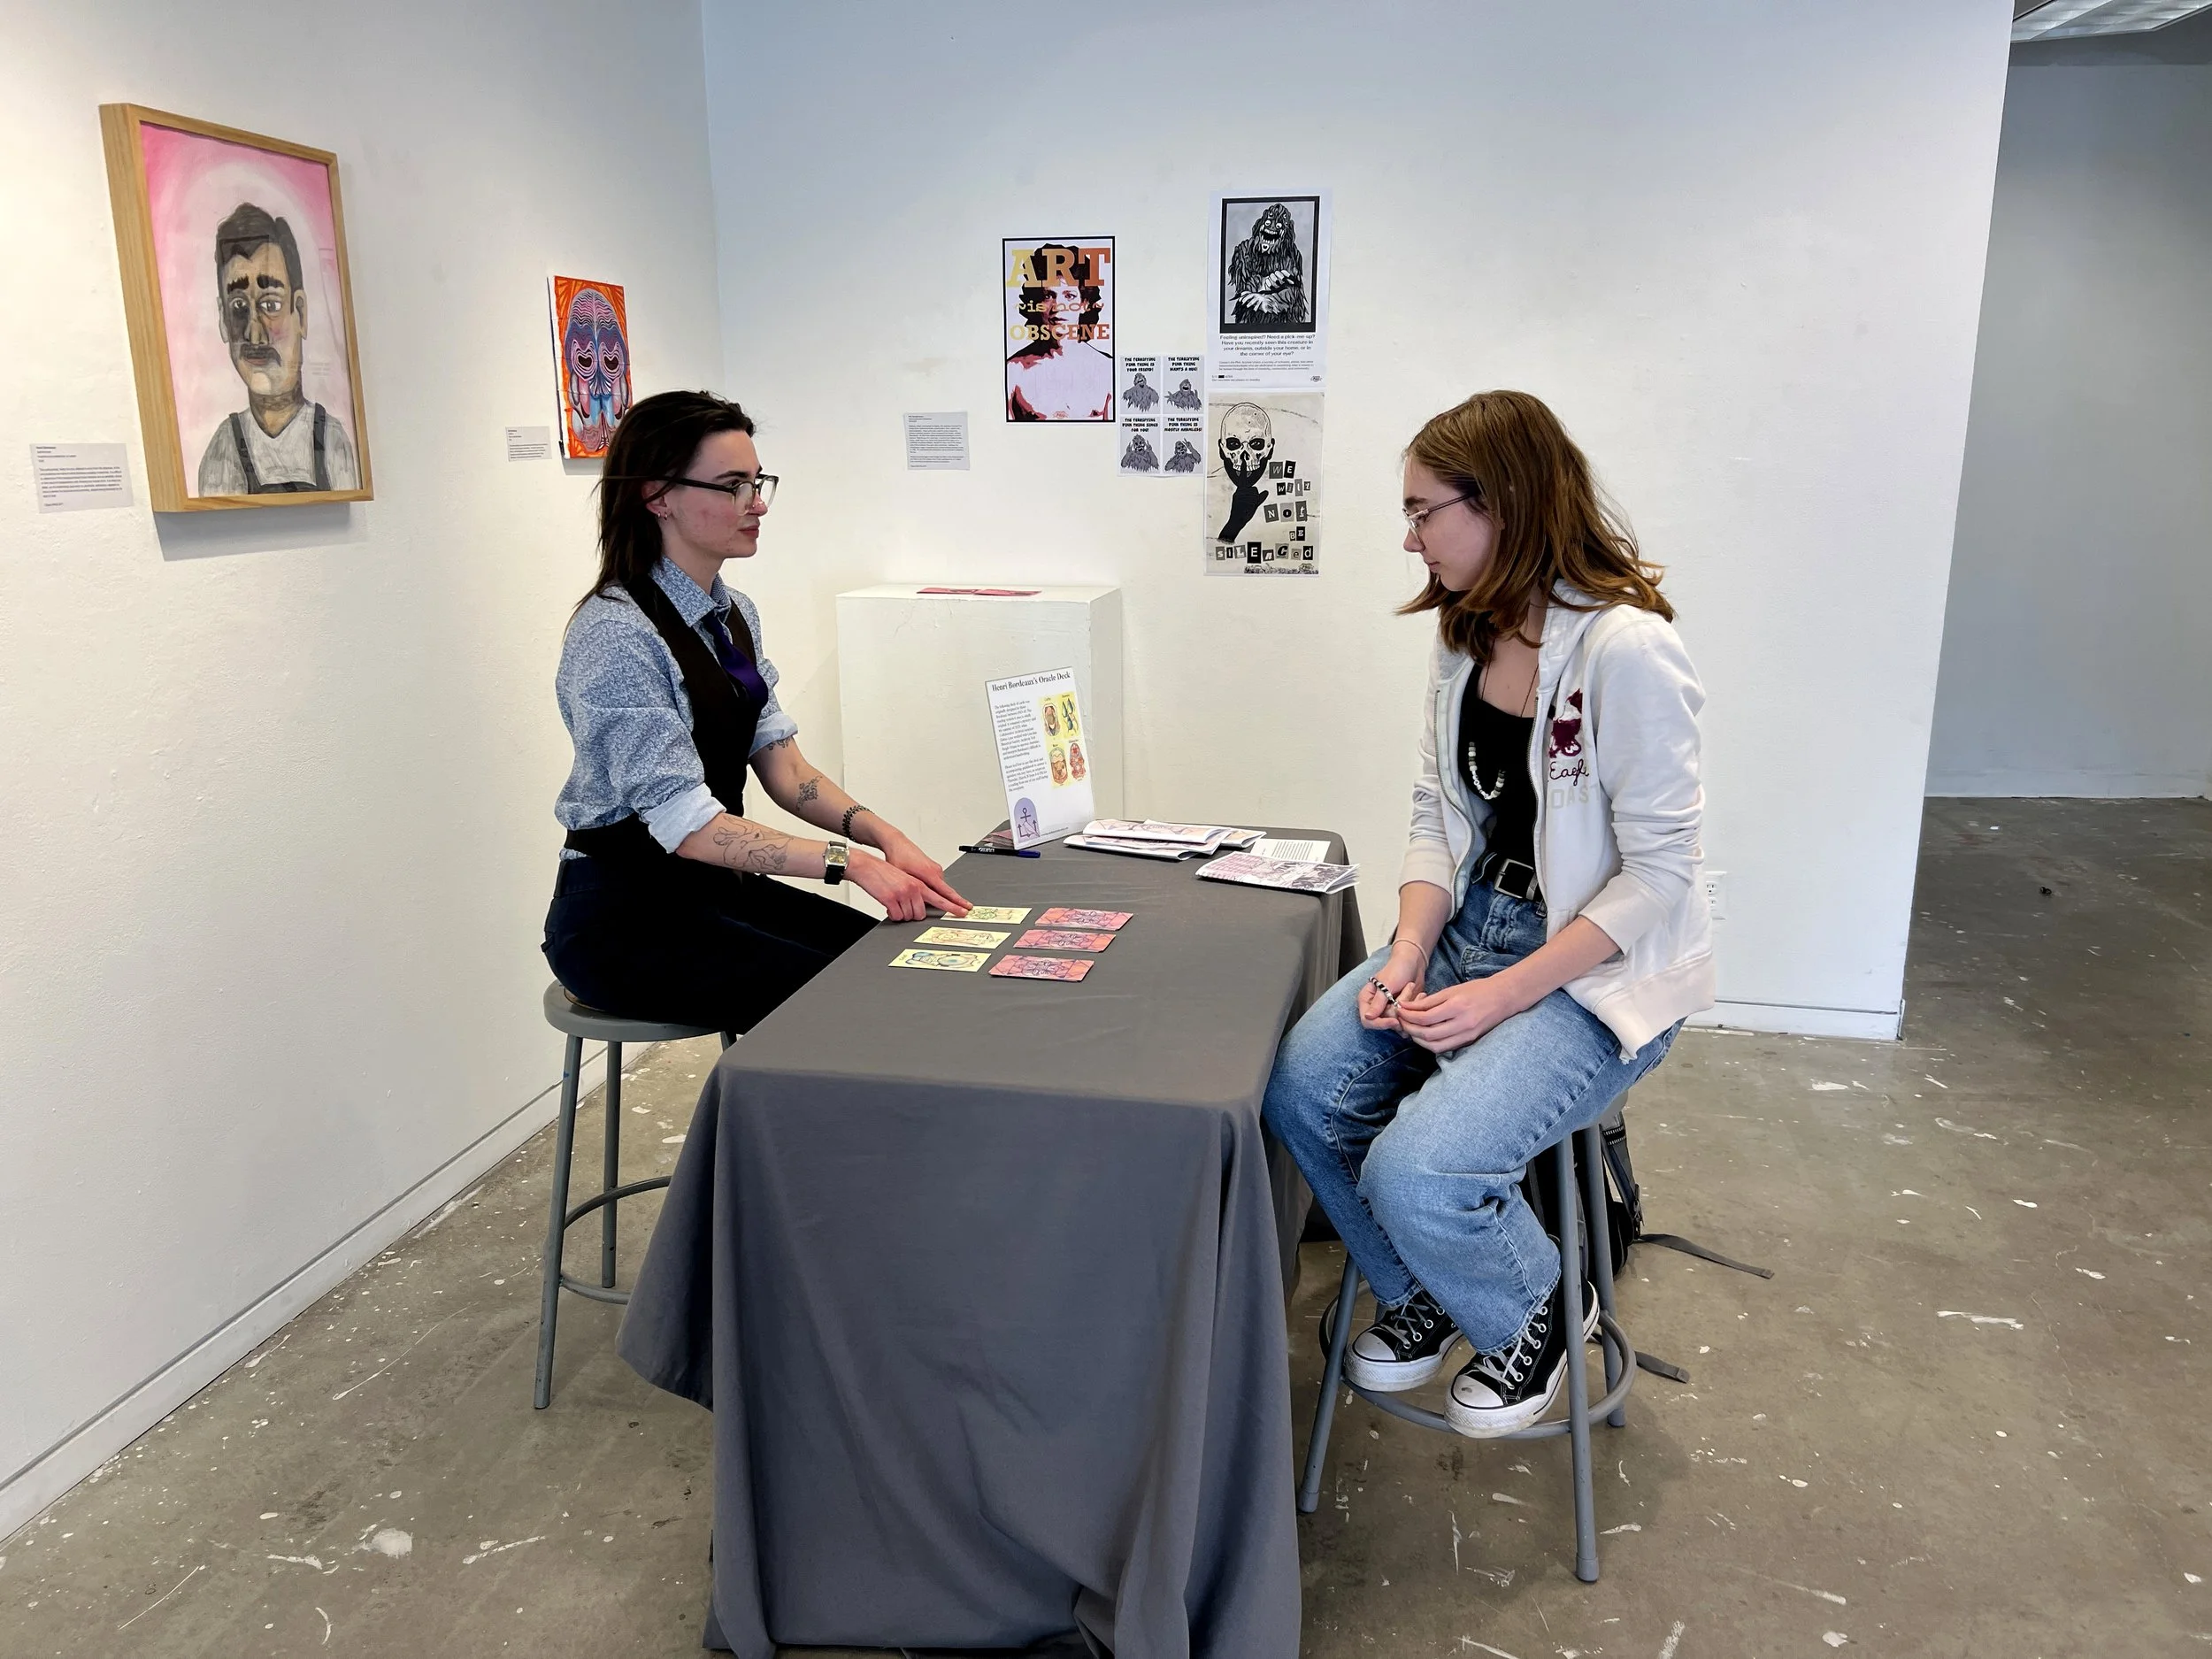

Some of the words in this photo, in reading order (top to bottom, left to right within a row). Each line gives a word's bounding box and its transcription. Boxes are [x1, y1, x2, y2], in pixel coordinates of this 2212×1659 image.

[1006, 248, 1110, 288] ART
[1010, 324, 1110, 342] OBSCENE
[992, 683, 1008, 692] Henri
[1008, 677, 1038, 689] Bordeaux's
[1038, 673, 1056, 684] Oracle
[1056, 671, 1071, 680] Deck
